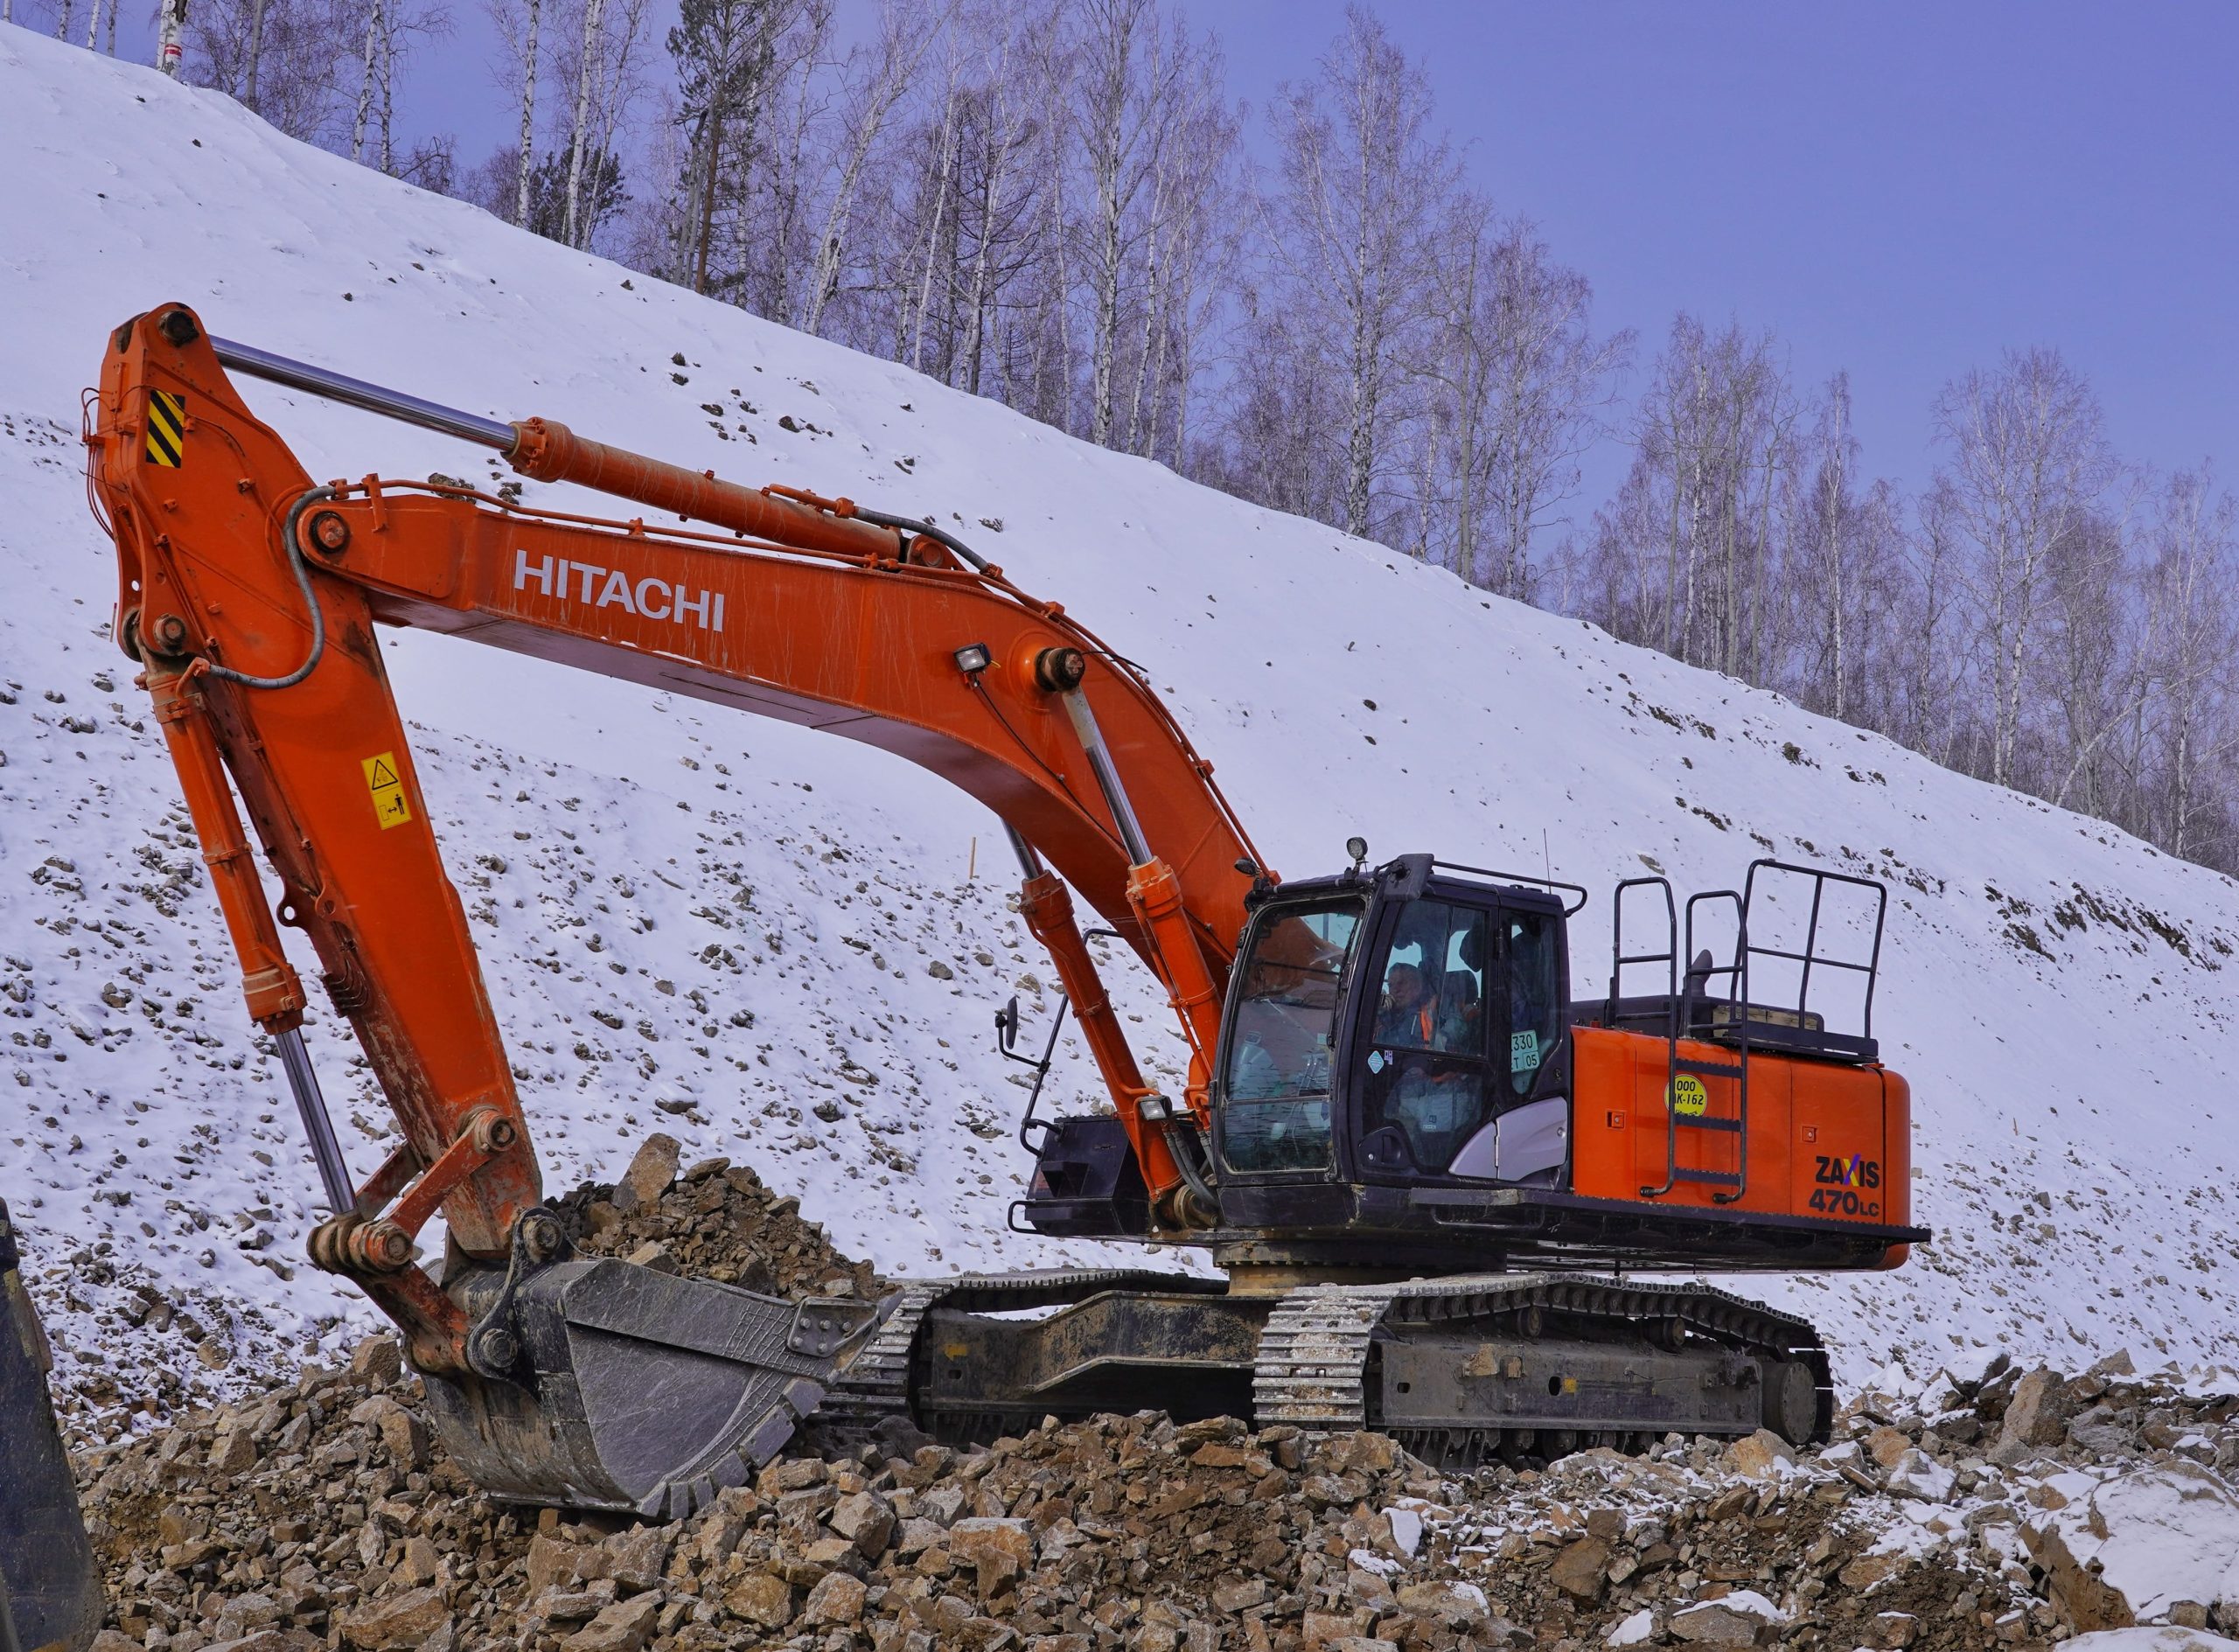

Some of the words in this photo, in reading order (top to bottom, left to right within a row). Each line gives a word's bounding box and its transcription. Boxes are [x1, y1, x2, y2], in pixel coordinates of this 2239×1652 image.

[513, 549, 724, 632] HITACHI
[1511, 1034, 1533, 1050] 330
[1526, 1054, 1537, 1066] 05
[1674, 1093, 1704, 1105] K-162
[1815, 1154, 1880, 1188] ZAXIS
